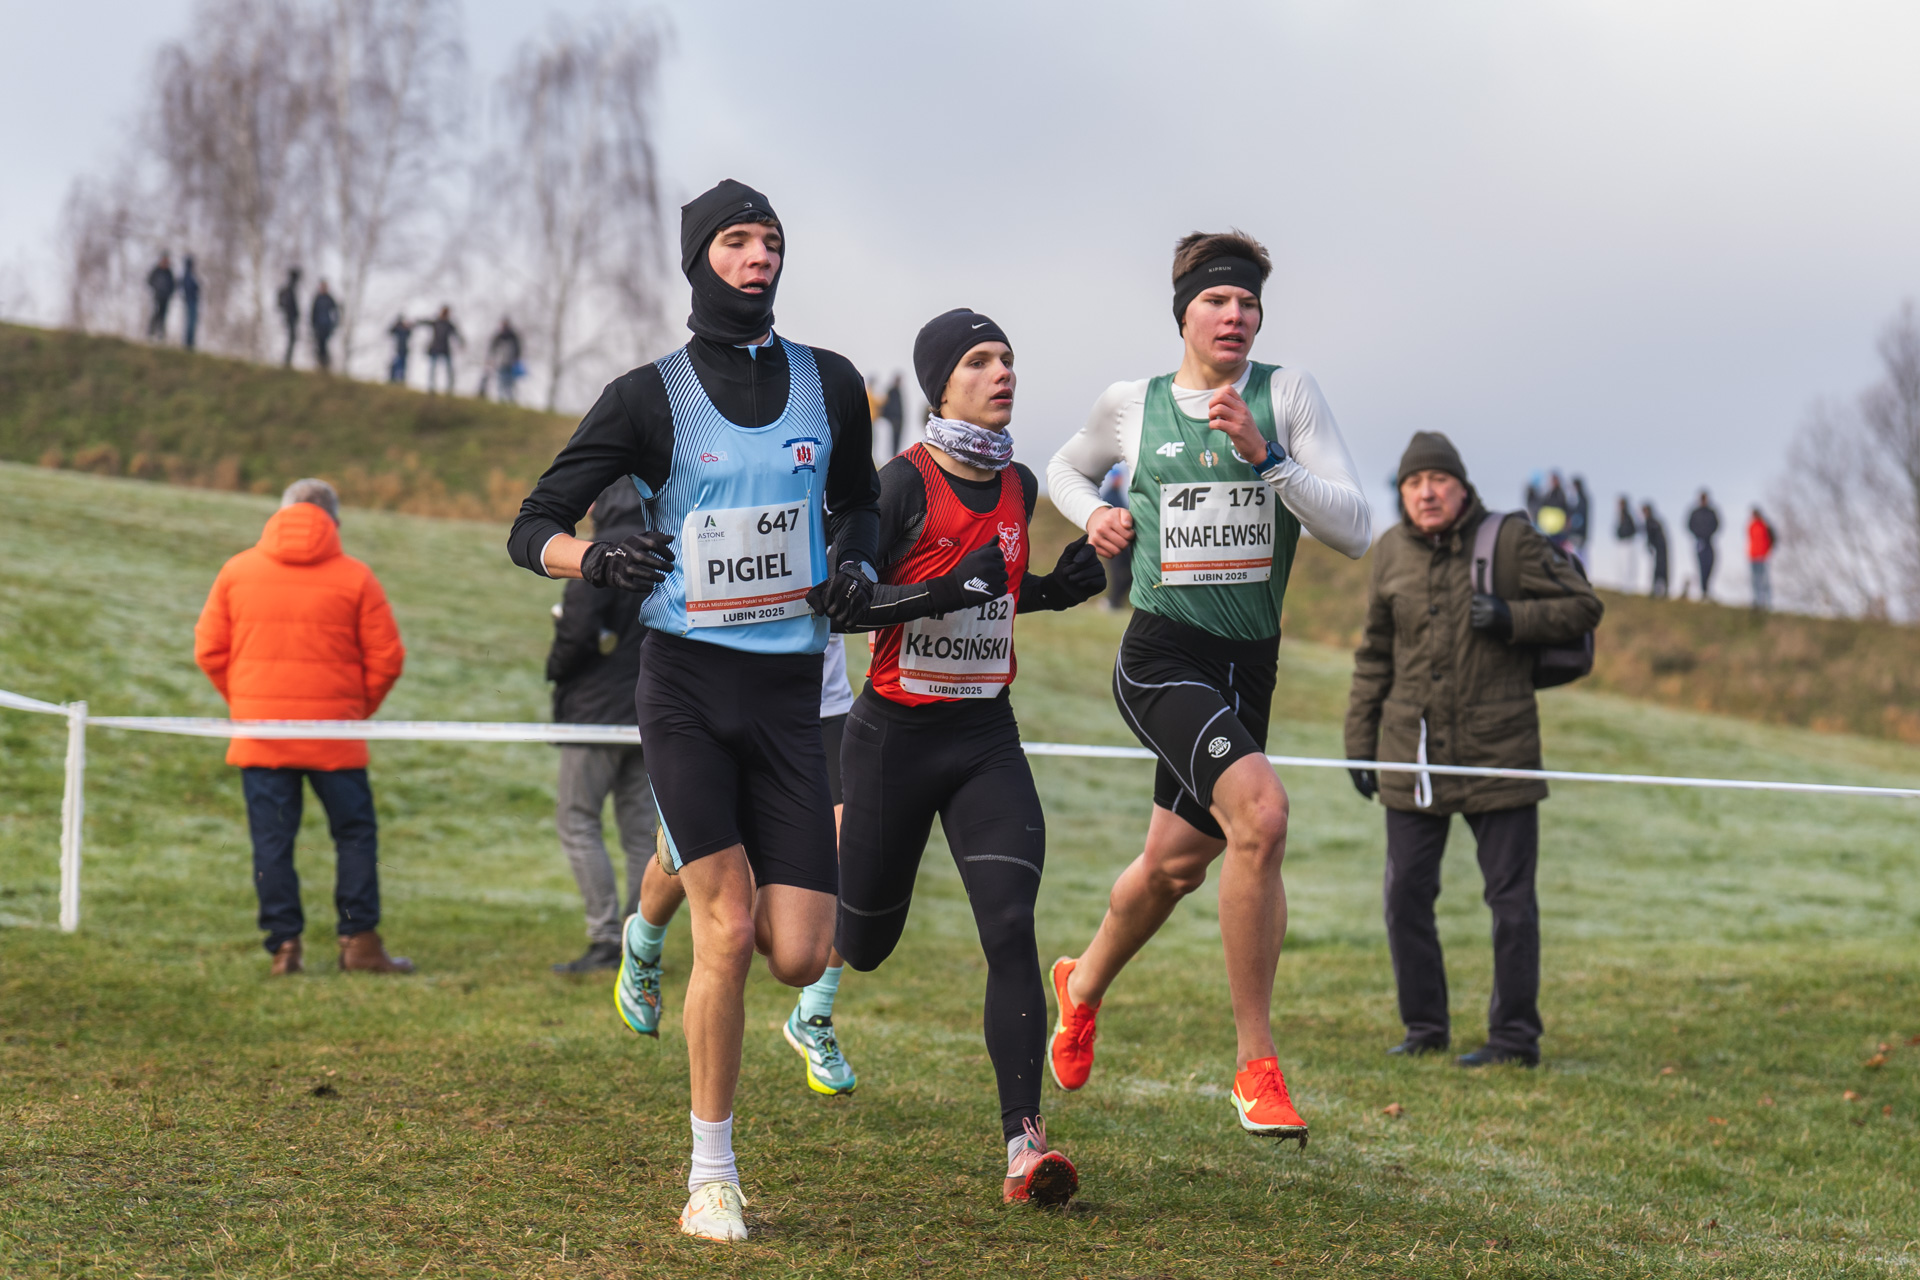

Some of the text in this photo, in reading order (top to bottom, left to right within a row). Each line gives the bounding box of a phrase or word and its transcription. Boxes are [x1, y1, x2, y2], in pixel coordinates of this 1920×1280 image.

[1156, 441, 1185, 457] 4F
[1168, 486, 1211, 511] 4F
[1228, 487, 1266, 507] 175
[757, 508, 799, 535] 647
[697, 531, 725, 539] ASTONE
[1165, 523, 1271, 549] KNAFLEWSKI
[707, 552, 792, 584] PIGIEL
[1193, 572, 1248, 582] LUBIN 2025
[969, 576, 989, 589] NIKE
[763, 595, 783, 603] Biegach
[723, 607, 785, 623] LUBIN 2025
[976, 600, 1008, 620] 182
[905, 632, 1008, 660] KŁOSIŃSKI
[929, 685, 982, 695] LUBIN 2025
